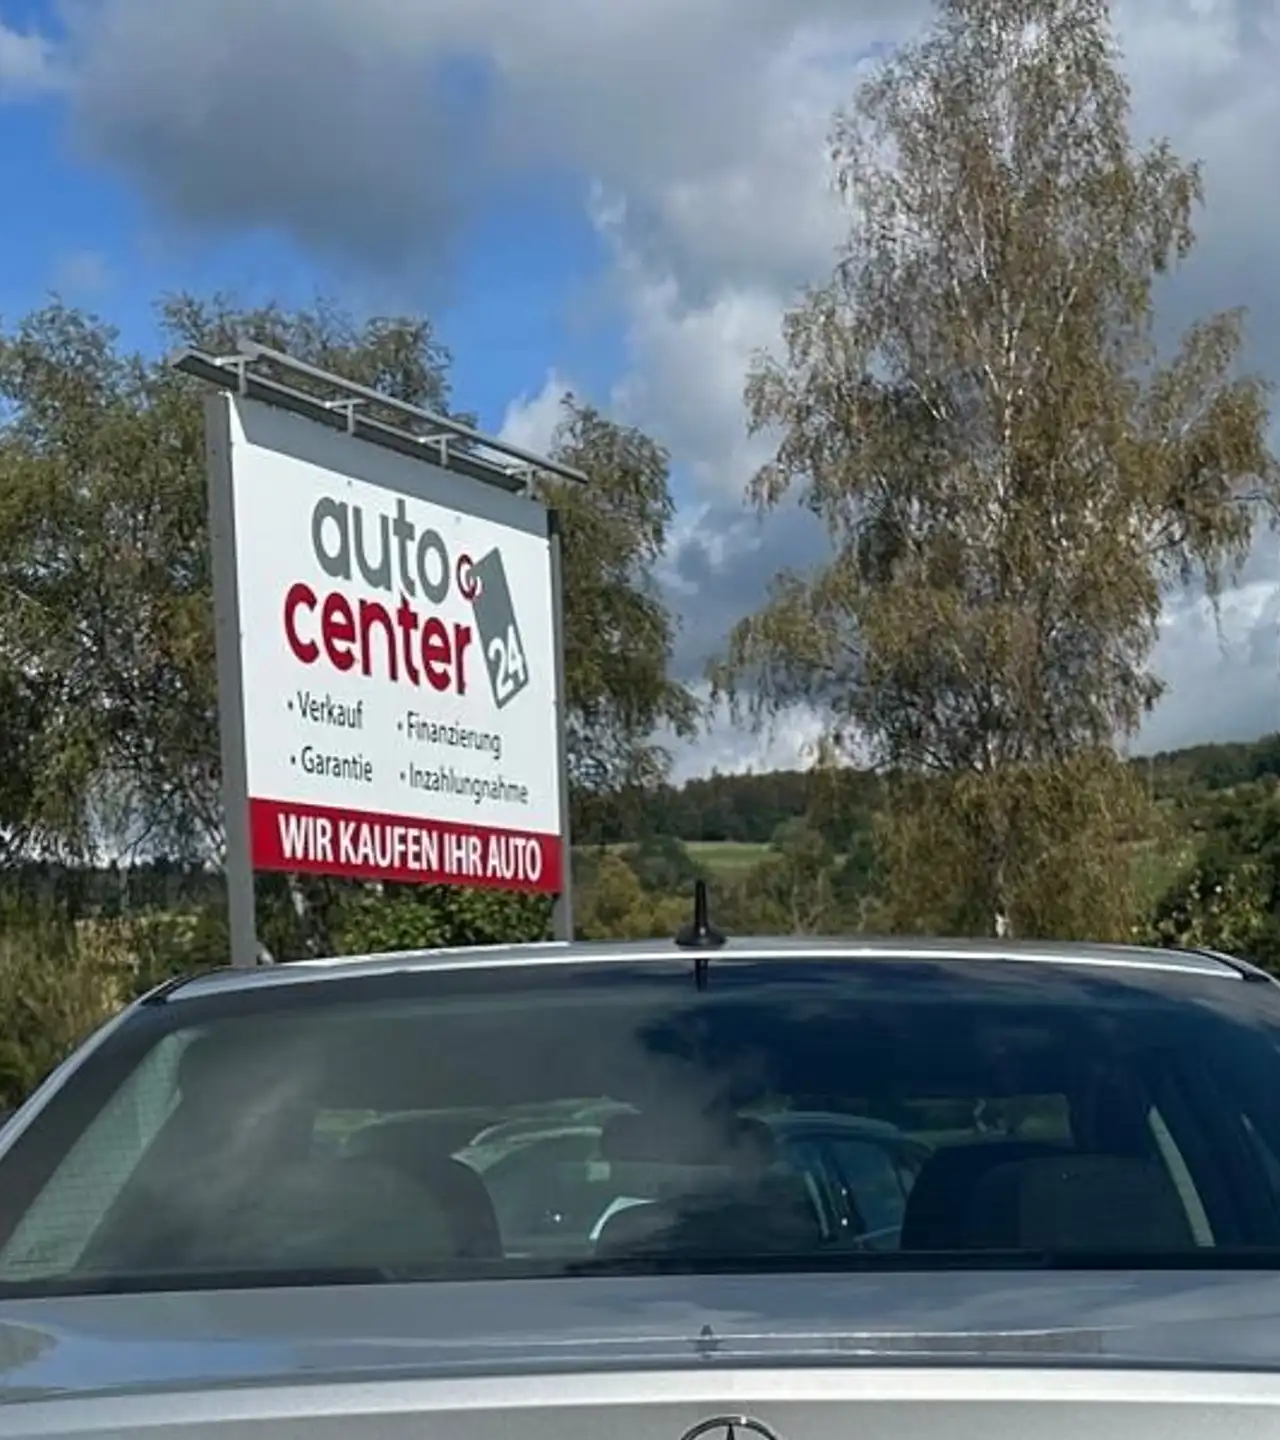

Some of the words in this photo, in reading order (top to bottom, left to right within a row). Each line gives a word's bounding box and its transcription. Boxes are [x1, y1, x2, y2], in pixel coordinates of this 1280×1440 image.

[311, 494, 450, 605] auto
[284, 582, 473, 696] center
[488, 624, 525, 698] 24
[297, 691, 364, 730] Verkauf
[407, 711, 502, 760] Finanzierung
[301, 746, 373, 782] Garantie
[409, 763, 529, 804] Inzahlungnahme
[278, 812, 334, 863] WIR
[338, 820, 438, 873] KAUFEN
[443, 834, 483, 877] IHR
[486, 836, 543, 882] AUTO
